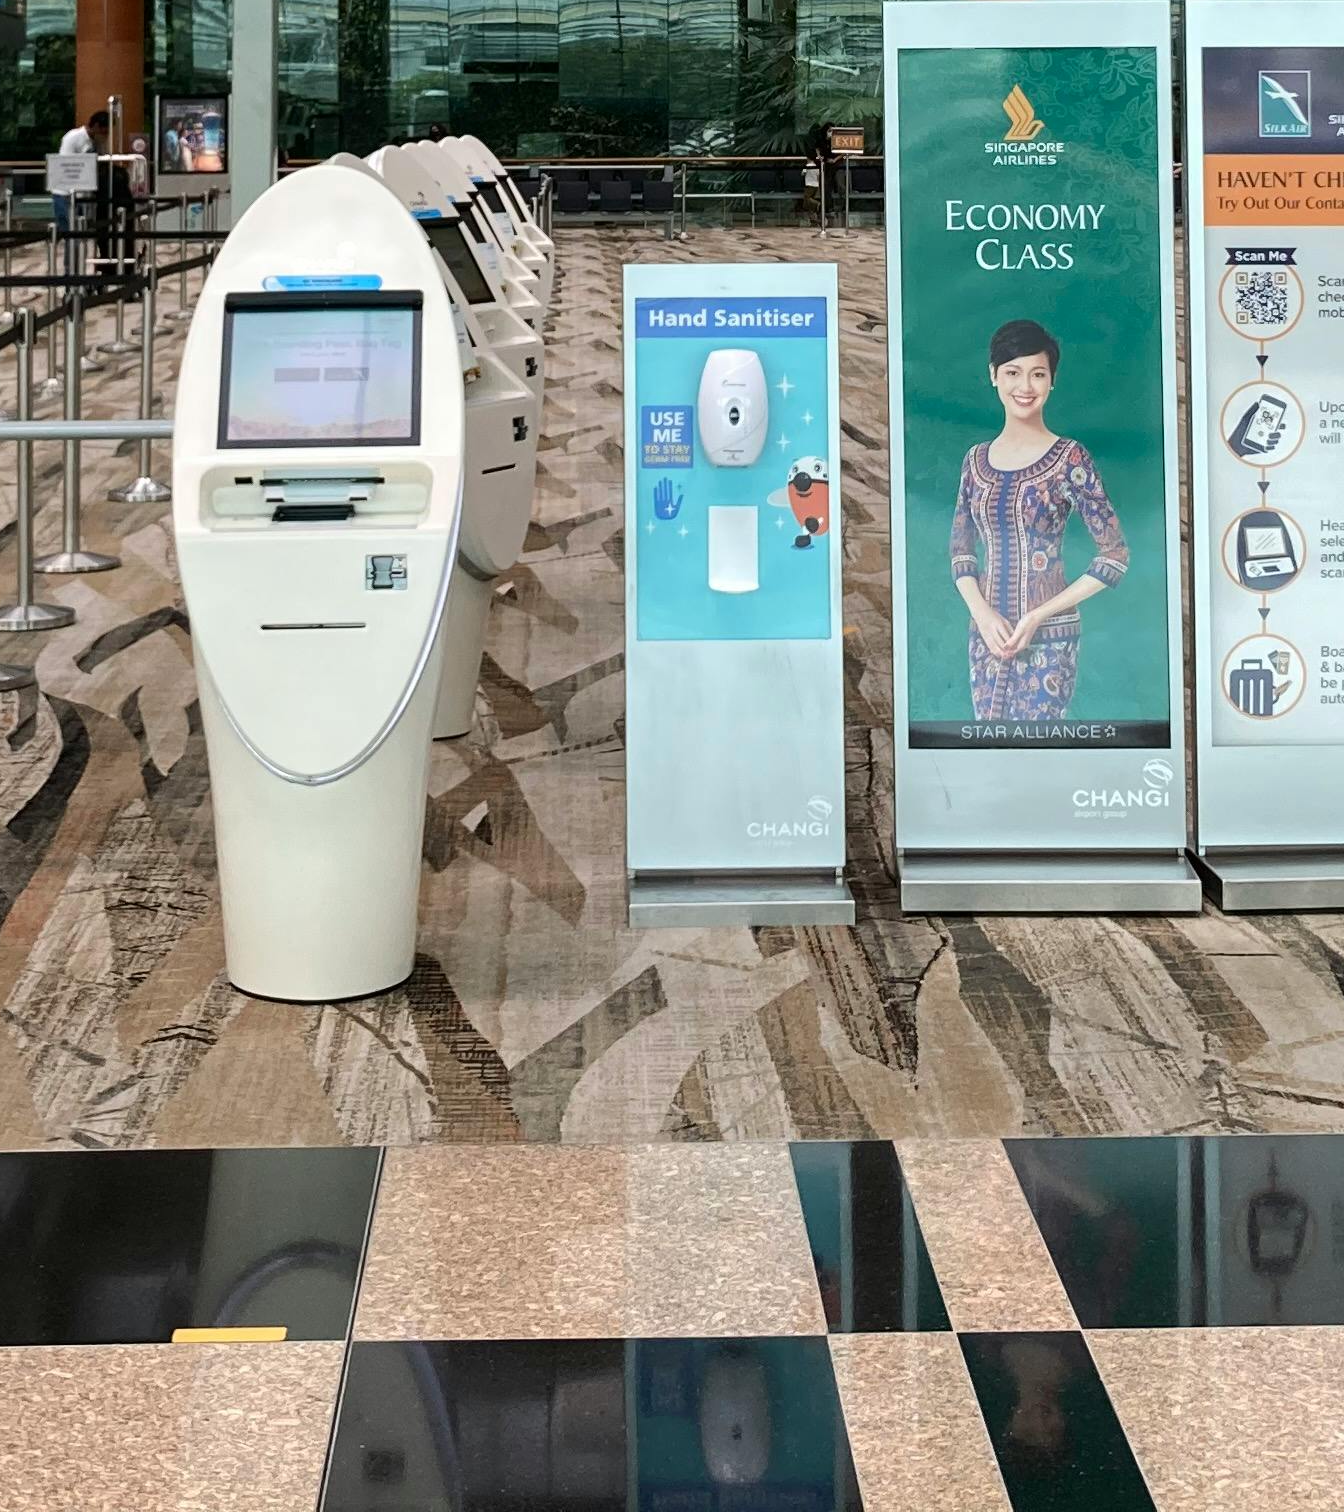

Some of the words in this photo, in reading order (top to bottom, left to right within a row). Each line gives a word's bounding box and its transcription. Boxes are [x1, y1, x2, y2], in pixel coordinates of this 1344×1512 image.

[835, 137, 860, 146] EXIT
[985, 143, 1064, 152] SINGAPORE
[993, 155, 1056, 165] AIRLINES
[1220, 197, 1237, 212] Try
[1244, 197, 1269, 209] Out
[1275, 197, 1300, 209] Our
[1235, 251, 1265, 261] Scan
[1269, 251, 1287, 261] Me
[650, 309, 706, 326] Hand
[715, 309, 814, 326] Sanitiser
[651, 412, 684, 426] USE
[654, 429, 681, 442] ME
[962, 725, 1006, 738] STAR
[1013, 725, 1100, 738] ALLIANCE
[1073, 790, 1169, 807] CHANGI
[747, 822, 828, 837] CHANGI
